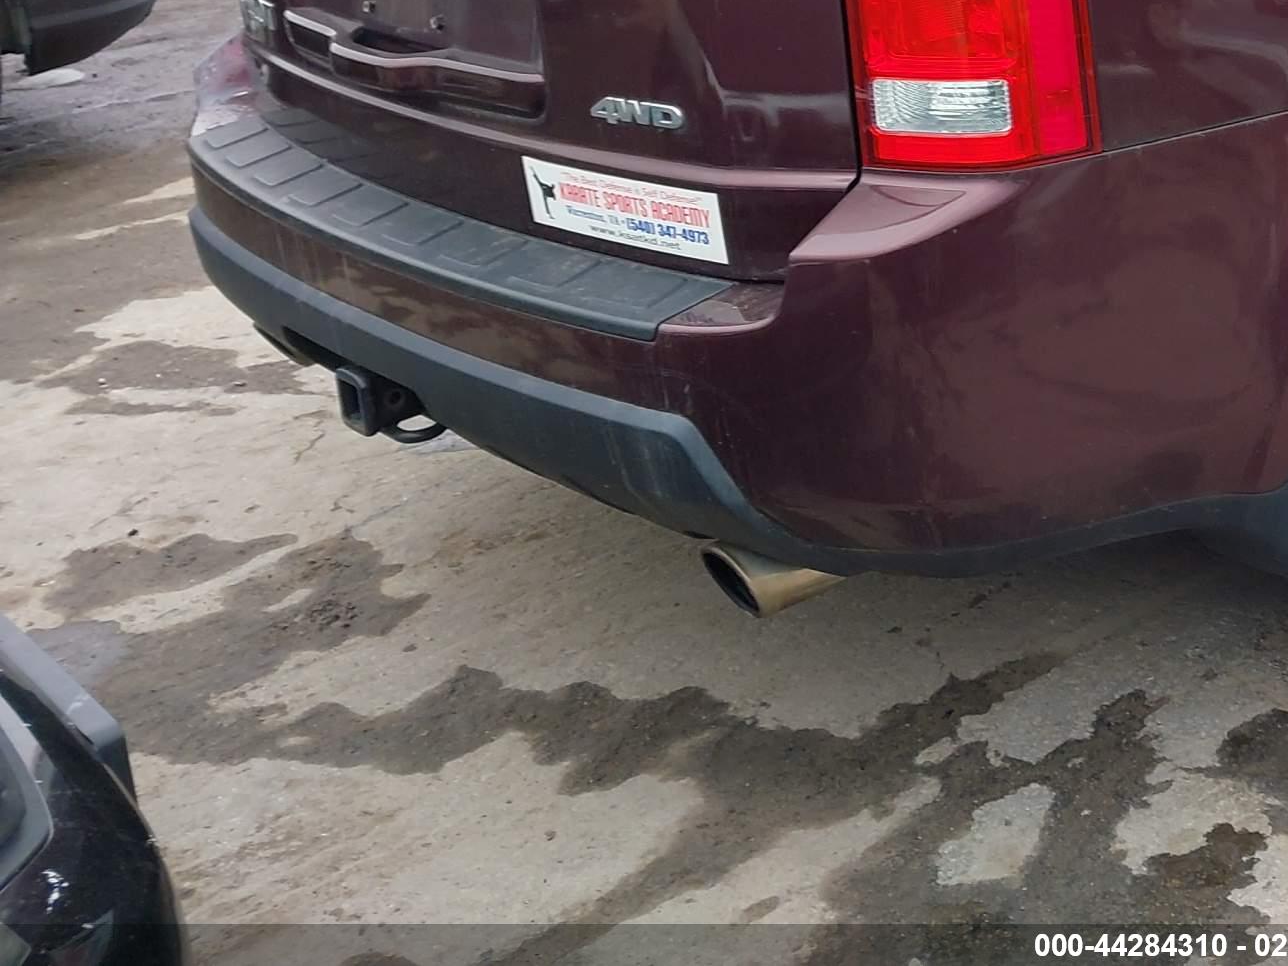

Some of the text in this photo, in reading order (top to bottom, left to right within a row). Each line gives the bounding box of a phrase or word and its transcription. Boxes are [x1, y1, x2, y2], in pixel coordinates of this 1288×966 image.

[590, 96, 683, 129] 4WD
[560, 182, 601, 207] KARATE
[602, 191, 648, 217] SPORTS
[651, 201, 710, 228] ACADEMY
[626, 217, 655, 235] (540)
[657, 223, 710, 245] 347-4973
